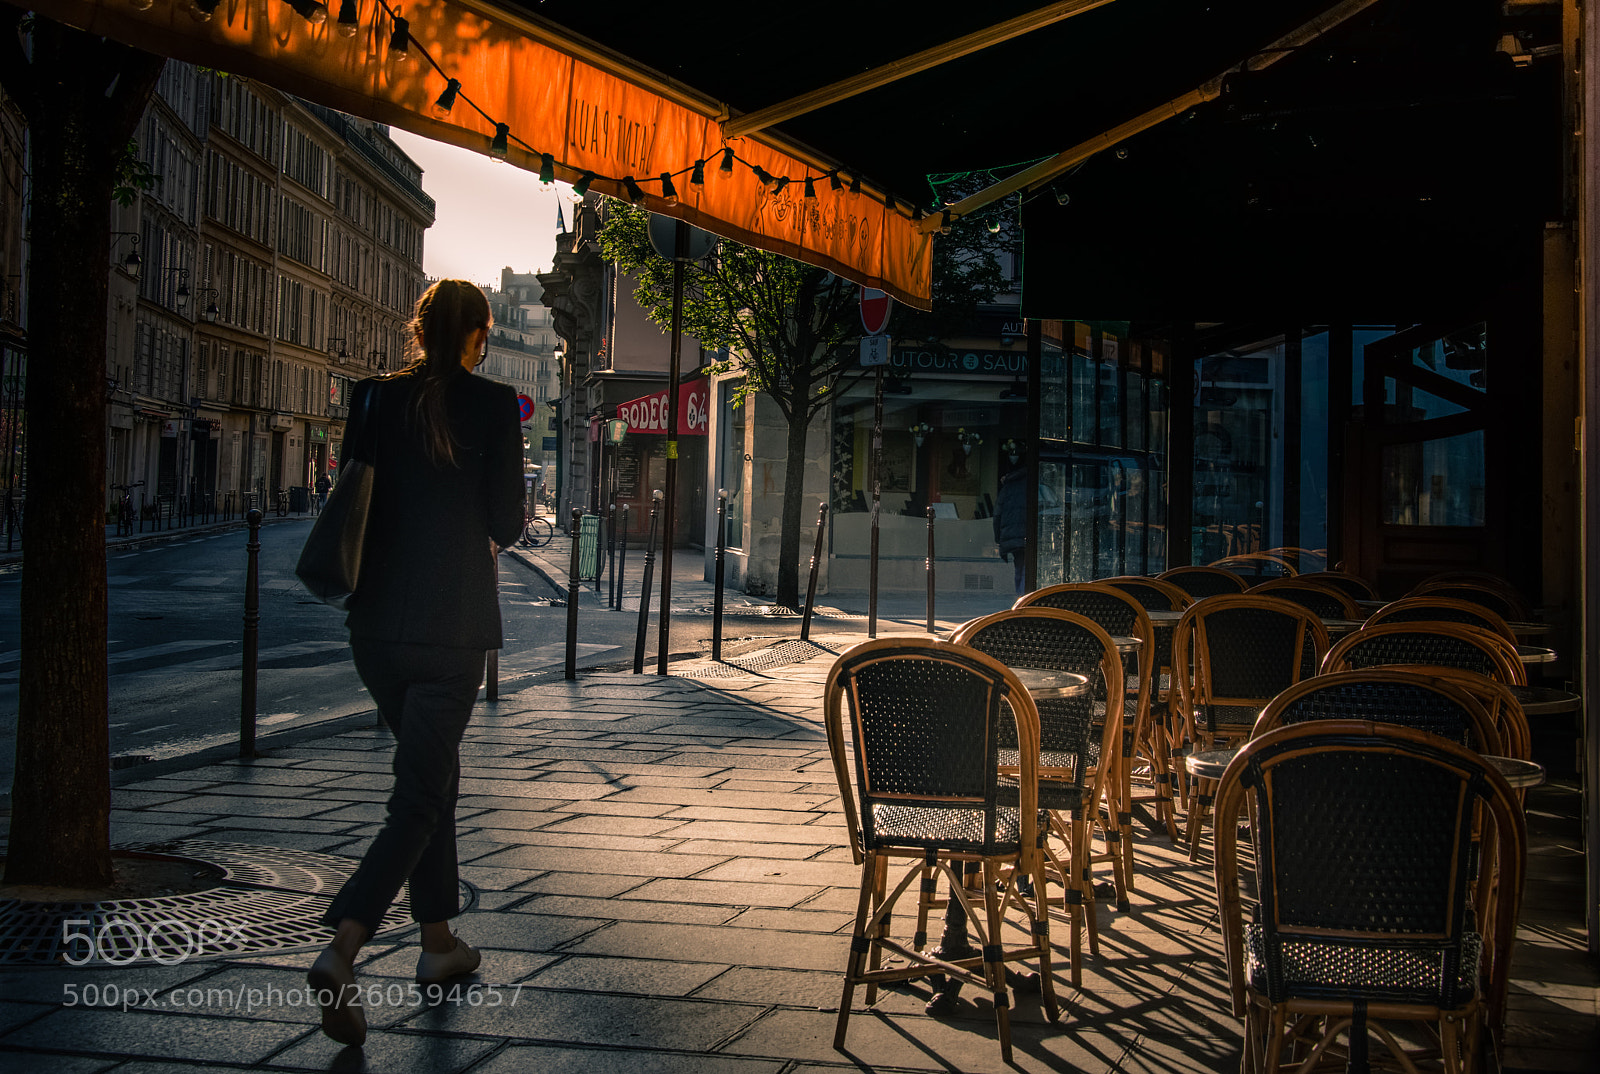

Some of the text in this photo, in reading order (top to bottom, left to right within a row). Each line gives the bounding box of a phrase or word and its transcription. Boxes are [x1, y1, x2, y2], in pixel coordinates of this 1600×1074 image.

[889, 350, 959, 369] UTOUR
[620, 391, 708, 432] BODEG 64
